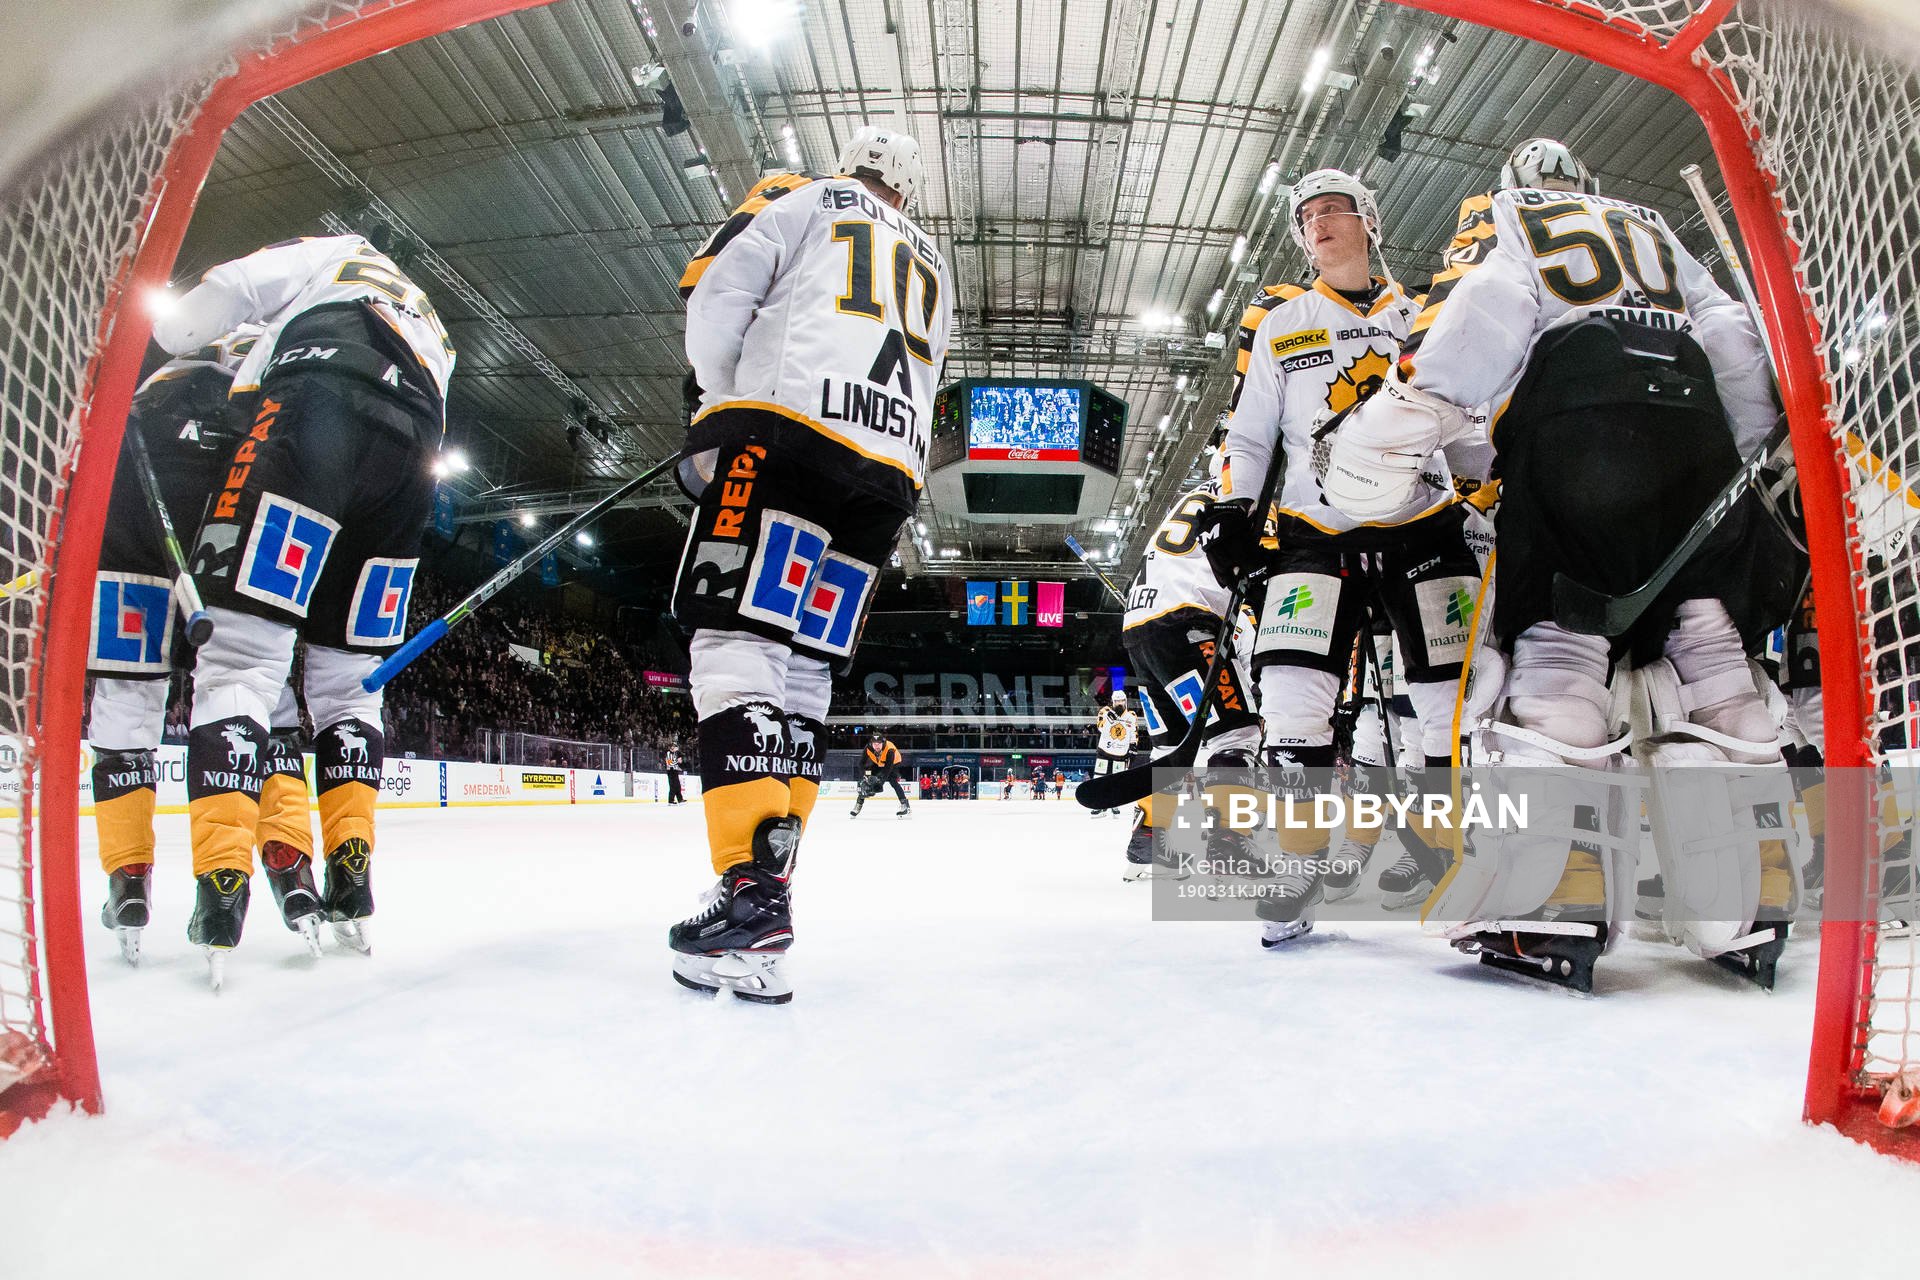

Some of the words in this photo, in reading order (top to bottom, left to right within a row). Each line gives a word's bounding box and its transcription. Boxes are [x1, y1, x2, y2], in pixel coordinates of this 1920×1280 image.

[1515, 201, 1687, 314] 50
[831, 220, 939, 366] 10
[1274, 332, 1326, 352] BROKK
[1283, 352, 1333, 373] ŠKODA
[213, 398, 283, 518] REPAY
[1336, 465, 1373, 486] PREMIER
[1406, 555, 1441, 579] CCM
[1260, 622, 1328, 641] martinsons
[725, 755, 769, 773] NOR
[1357, 755, 1376, 763] CCM
[107, 771, 142, 788] NOR
[202, 770, 240, 789] NOR
[324, 765, 353, 780] NOR
[523, 774, 565, 784] HYRPOOLEN
[463, 783, 511, 796] SMEDERNA
